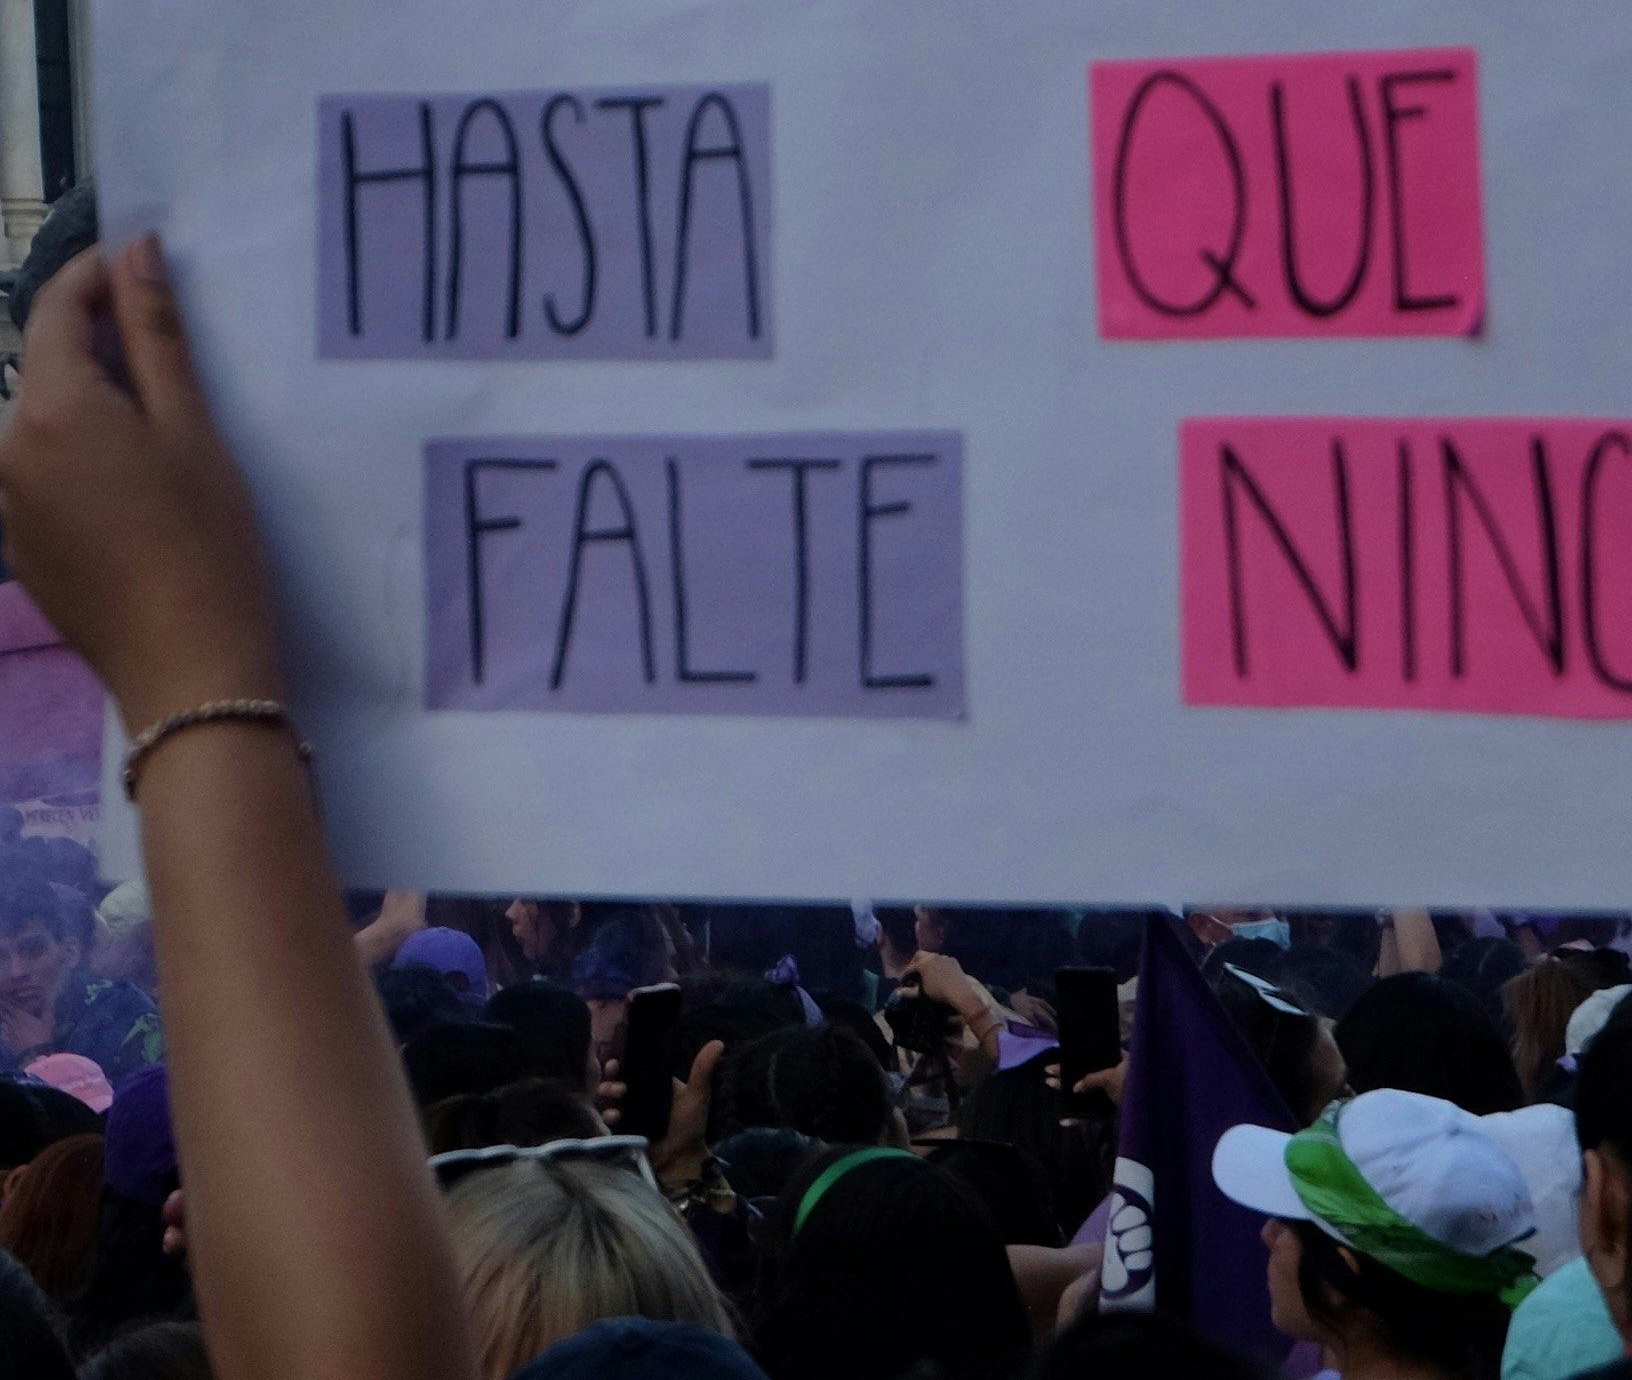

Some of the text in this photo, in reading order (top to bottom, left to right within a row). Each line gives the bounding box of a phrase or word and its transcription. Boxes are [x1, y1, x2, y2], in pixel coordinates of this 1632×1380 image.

[343, 69, 1460, 343] HASTA QUE
[464, 453, 938, 692] FALTE
